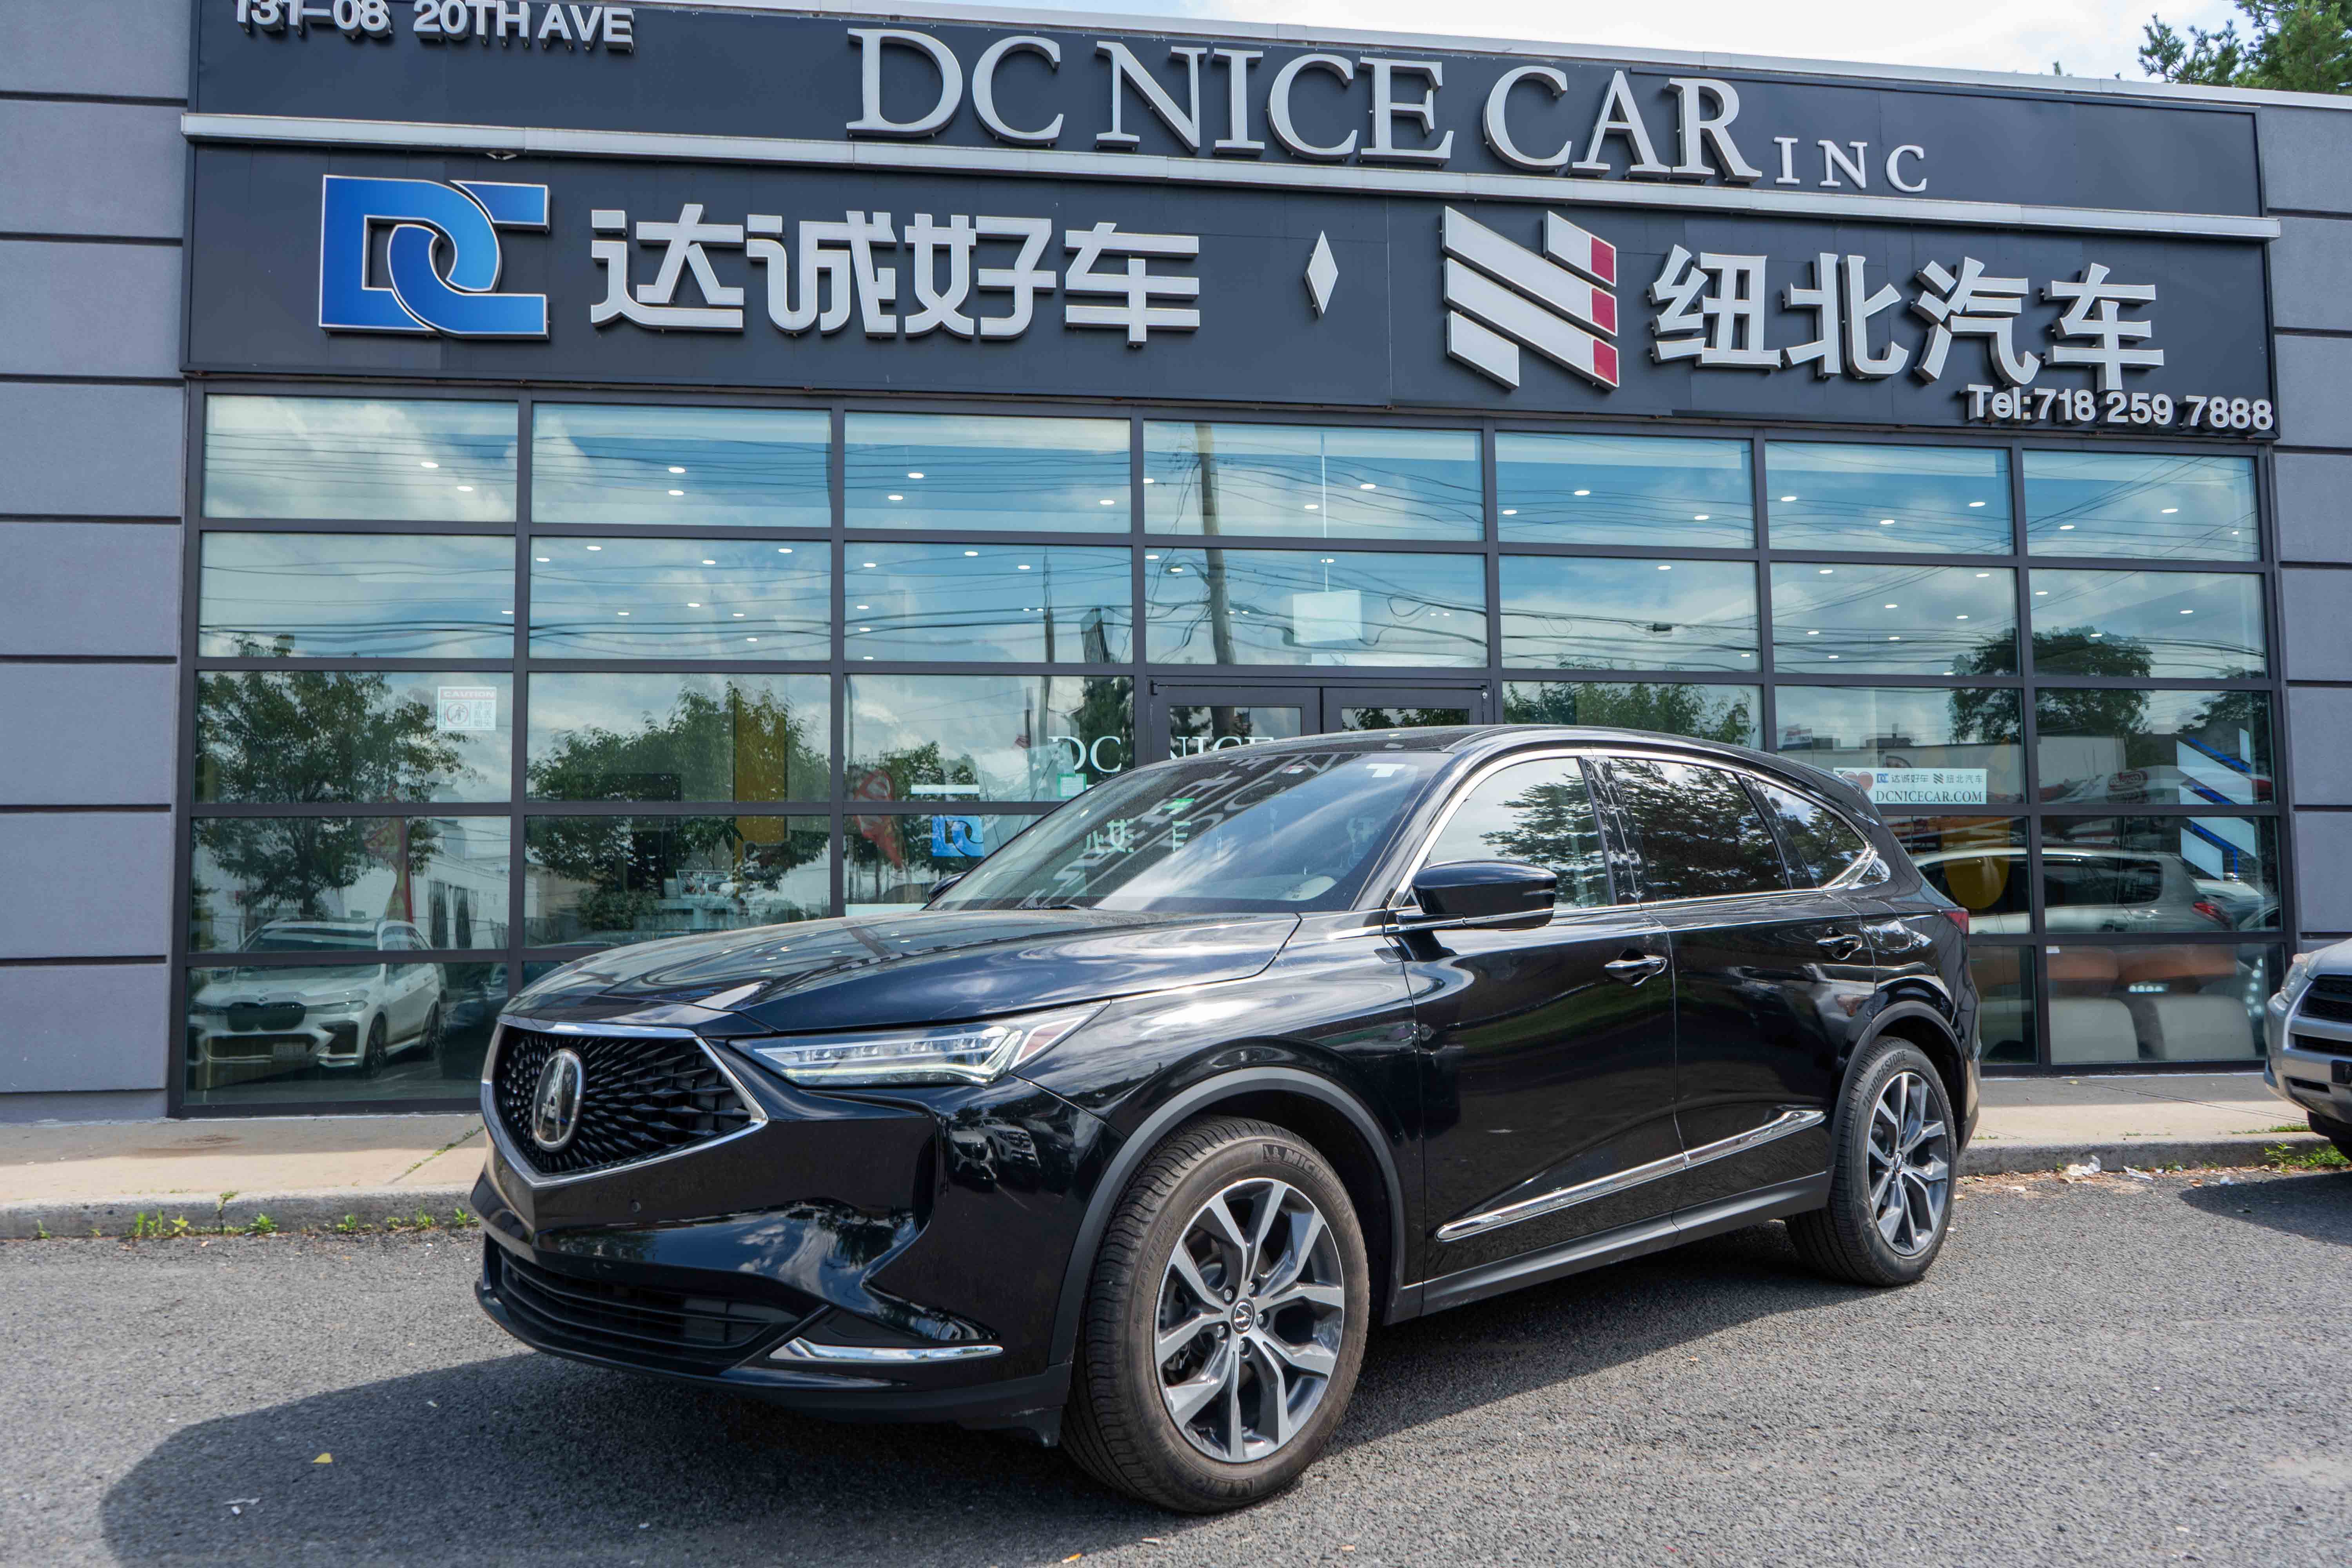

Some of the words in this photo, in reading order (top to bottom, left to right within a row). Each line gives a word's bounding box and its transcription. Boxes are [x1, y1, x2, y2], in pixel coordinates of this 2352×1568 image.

[413, 0, 530, 41] 20TH
[538, 2, 633, 47] AVE
[846, 27, 1064, 142] DC
[1095, 41, 1454, 161] NICE
[1482, 65, 1763, 180] CAR
[1773, 136, 1929, 194] INC
[318, 174, 550, 338] DC
[590, 203, 1201, 346] 达诚好车
[1651, 243, 2165, 391] 纽北汽车
[2107, 392, 2174, 425] 259
[2185, 395, 2274, 430] 7888
[1047, 736, 1122, 773] DC
[1875, 790, 1982, 802] DCNICECAR.COM
[1891, 773, 1929, 784] 达诚好车
[1946, 774, 1984, 784] 纽北汽车
